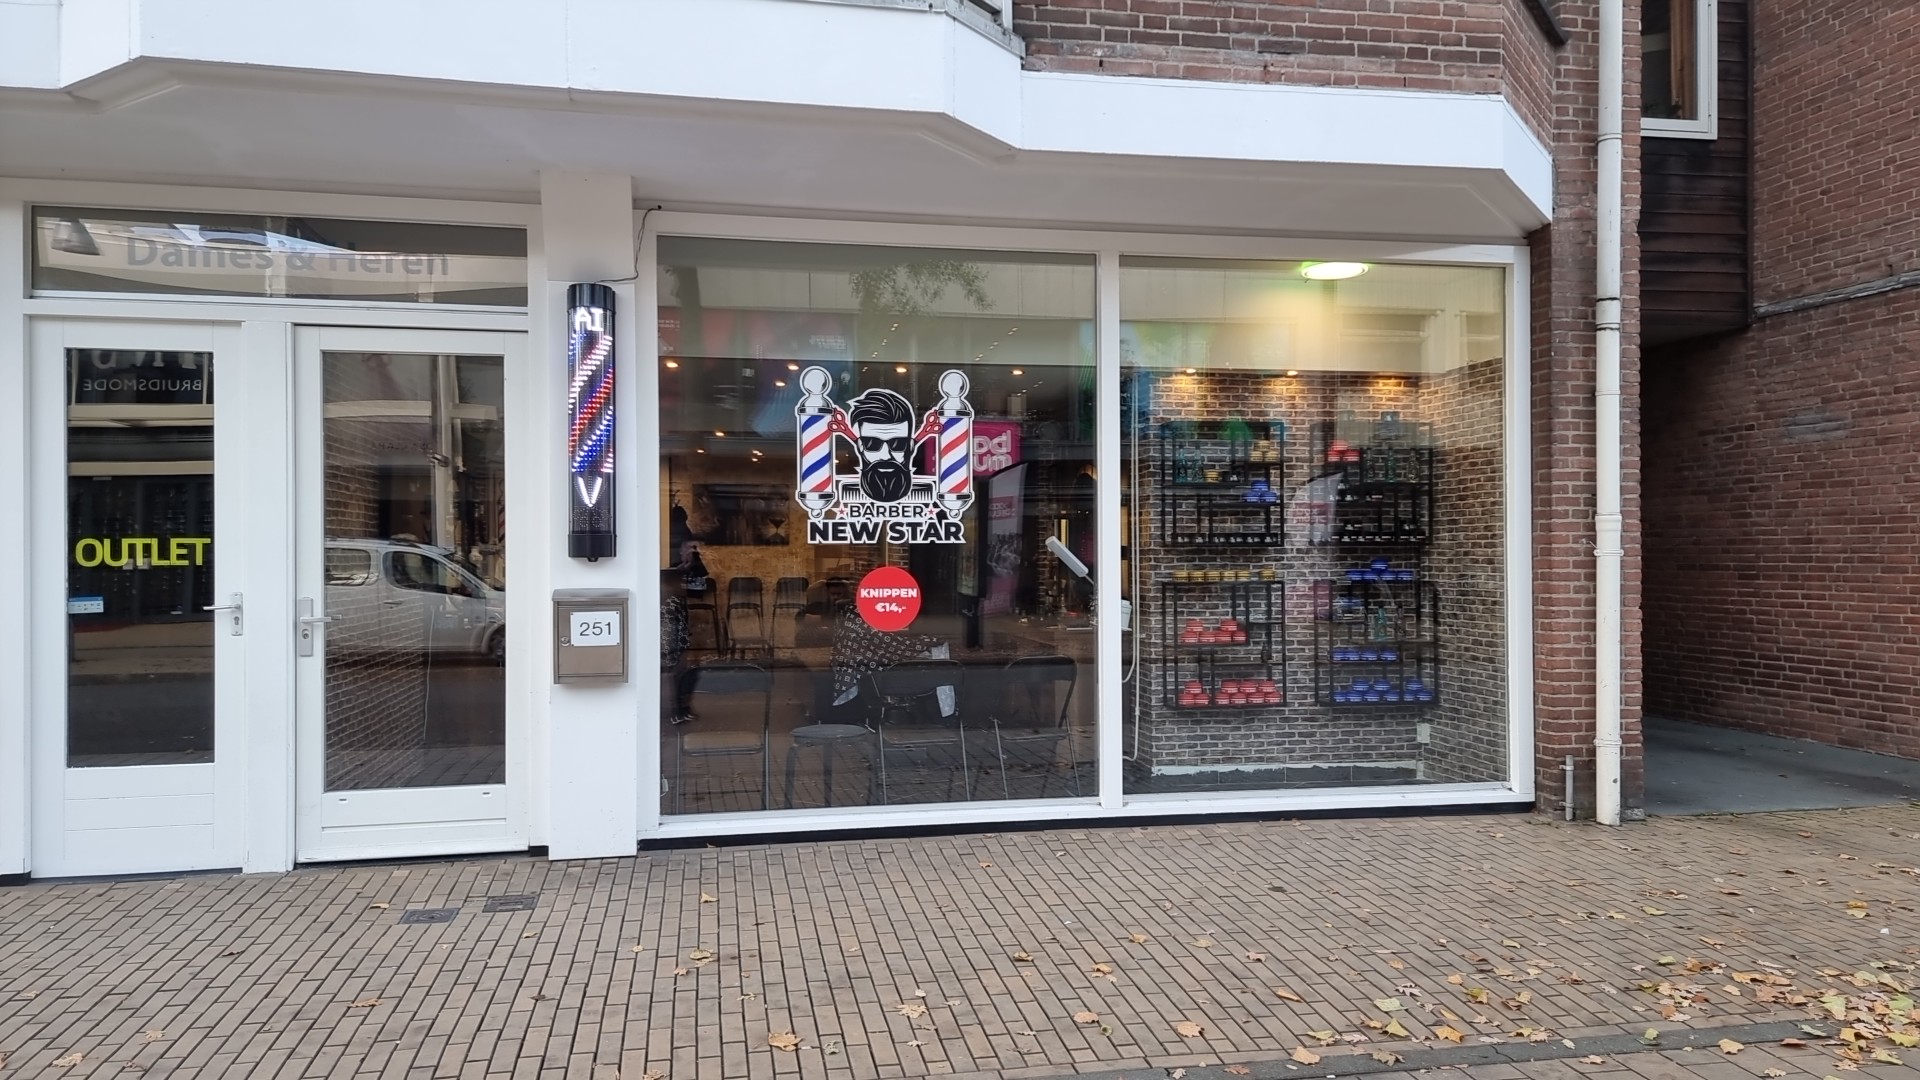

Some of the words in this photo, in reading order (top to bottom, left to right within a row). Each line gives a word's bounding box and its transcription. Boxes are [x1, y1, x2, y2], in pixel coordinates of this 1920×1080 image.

[127, 237, 273, 270] Dames
[286, 241, 316, 271] &
[329, 242, 449, 275] Heren
[850, 505, 924, 518] BARBER
[809, 521, 880, 542] NEW
[888, 521, 963, 542] STAR
[75, 537, 212, 568] OUTLET
[861, 588, 917, 598] KNIPPEN
[875, 602, 906, 613] €14,-
[579, 621, 611, 636] 251
